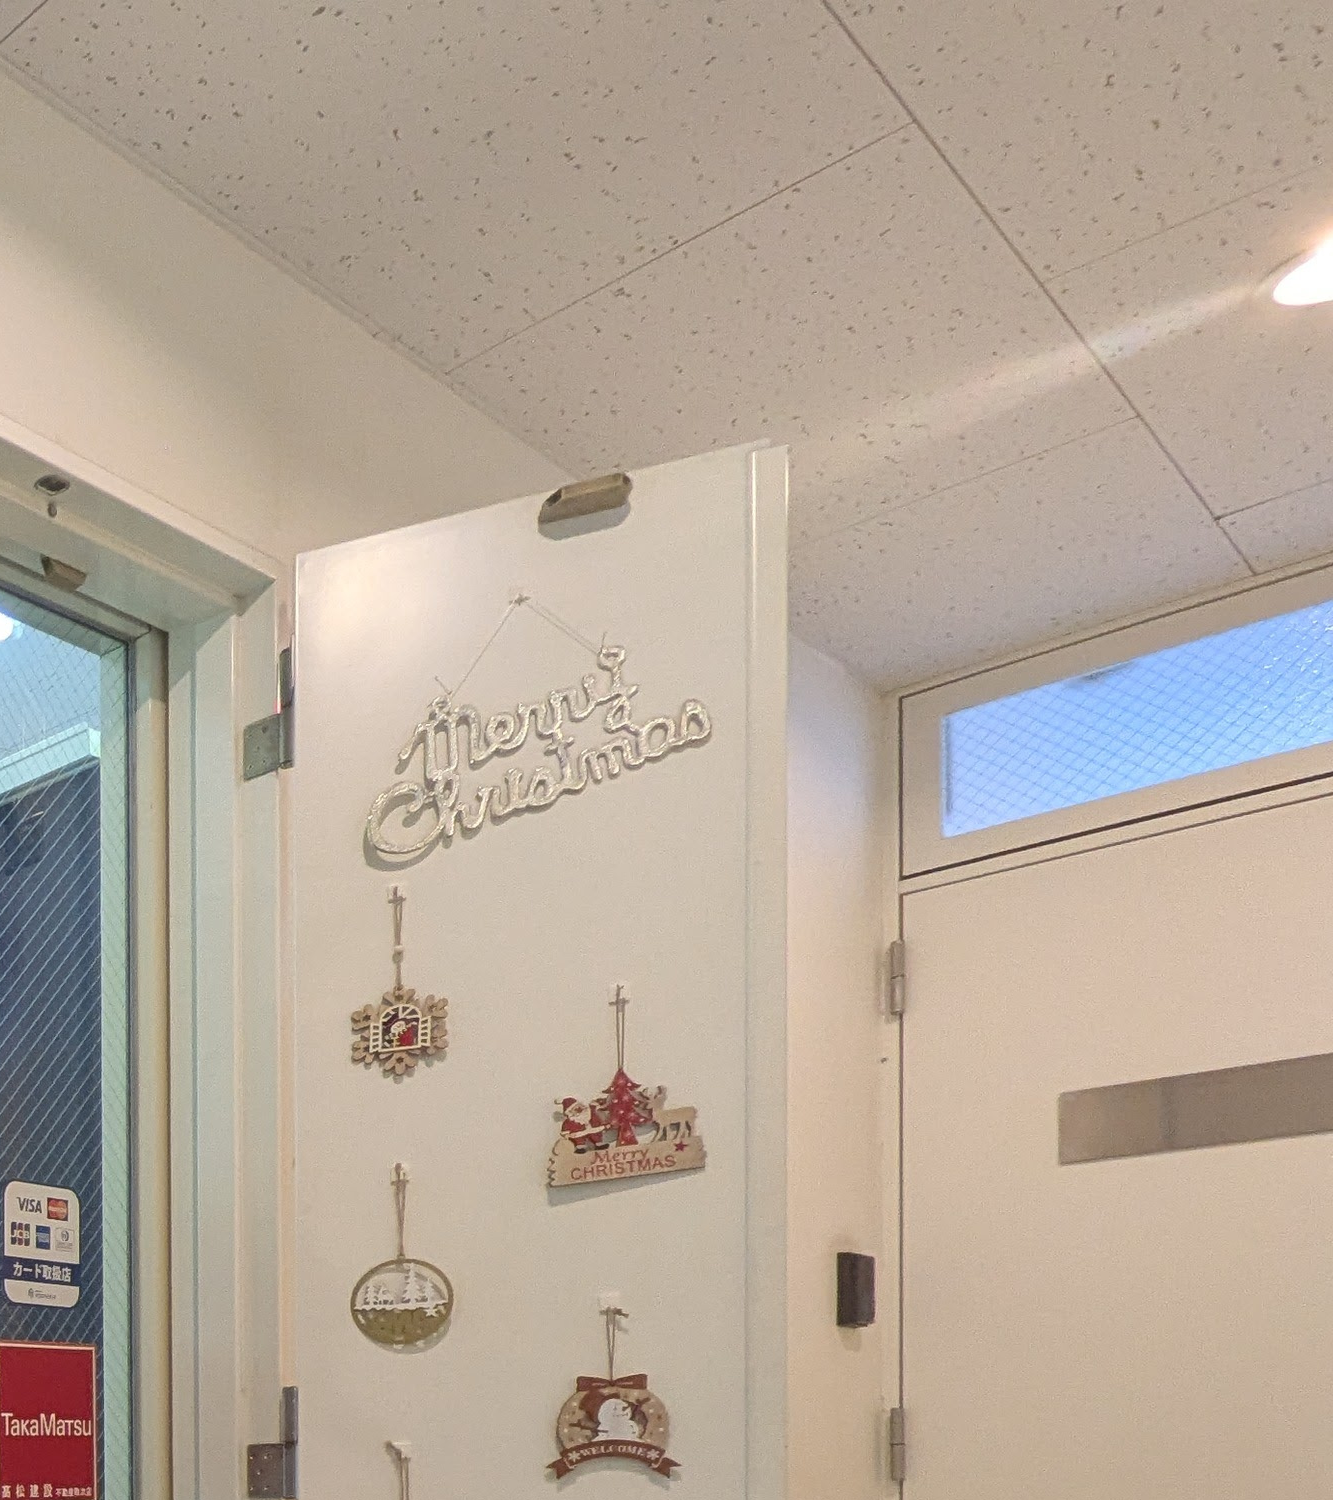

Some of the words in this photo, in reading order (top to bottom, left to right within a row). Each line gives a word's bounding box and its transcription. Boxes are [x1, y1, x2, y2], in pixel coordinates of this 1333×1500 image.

[397, 645, 639, 780] Merry
[366, 699, 713, 855] Christmas
[592, 1149, 649, 1165] Merry
[570, 1154, 677, 1181] CHRISTMAS
[17, 1197, 42, 1213] VISA
[13, 1262, 72, 1282] カード取扱店
[579, 1444, 648, 1457] WELCOME
